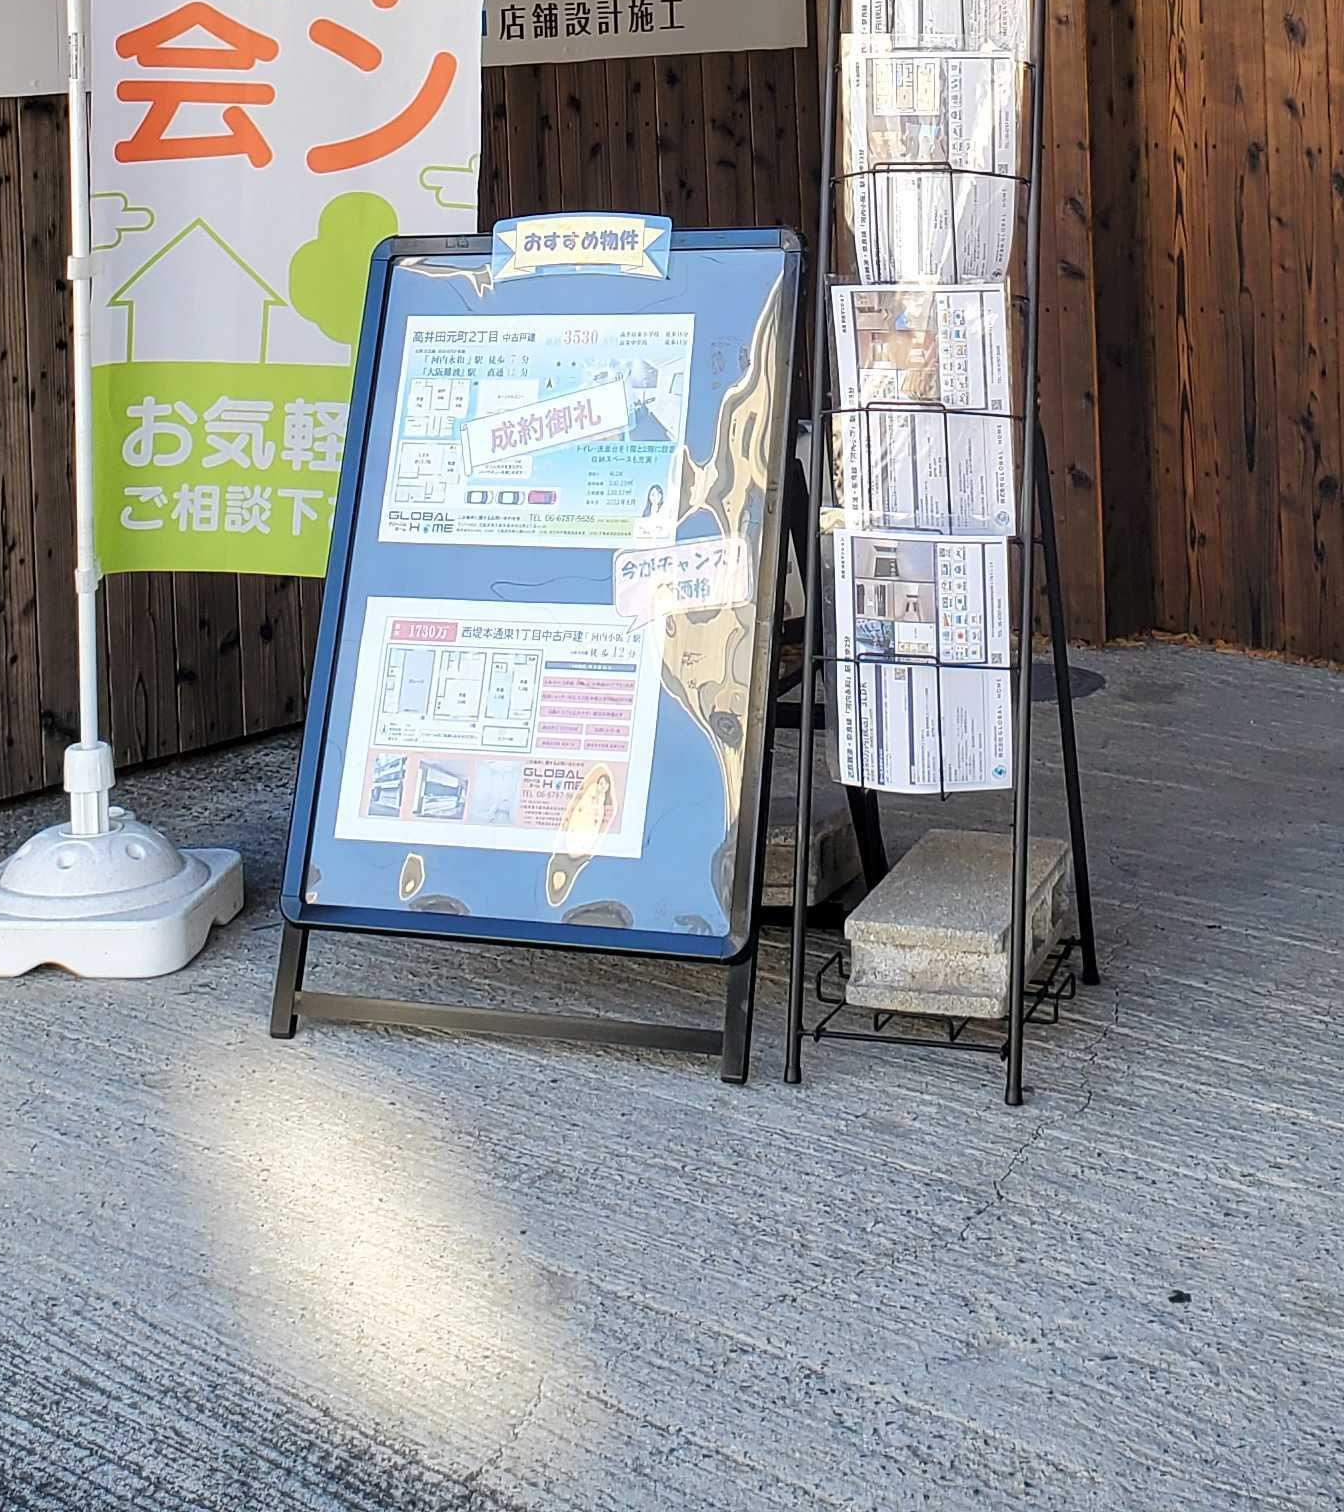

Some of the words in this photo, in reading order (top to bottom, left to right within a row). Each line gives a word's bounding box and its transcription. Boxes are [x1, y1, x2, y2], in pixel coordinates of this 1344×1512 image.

[523, 228, 639, 252] おすすめ物件
[489, 398, 602, 454] 成約御礼
[120, 482, 340, 537] ご相談下
[388, 510, 455, 522] GLOBAL
[408, 624, 449, 640] 1730万
[523, 767, 585, 780] GLOBAL
